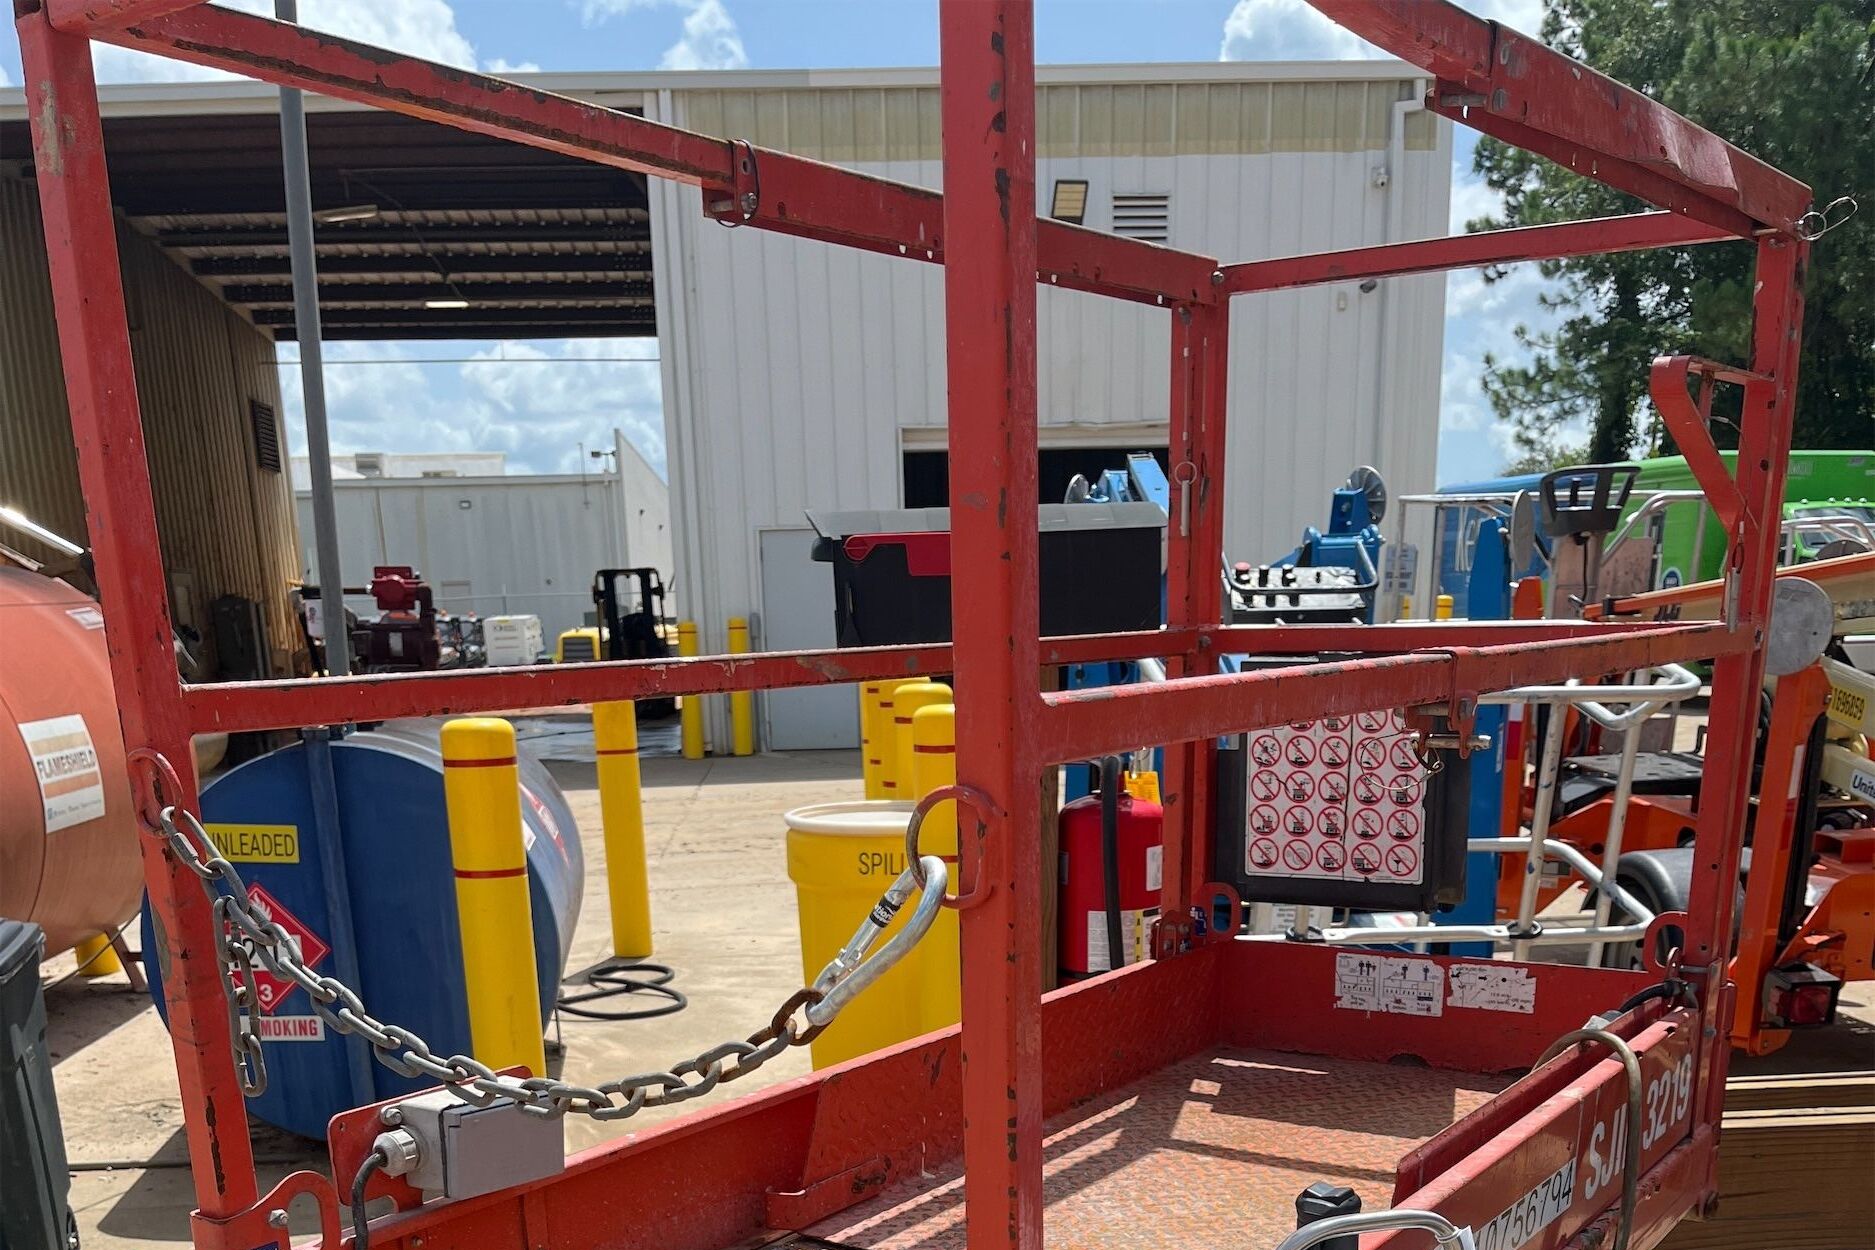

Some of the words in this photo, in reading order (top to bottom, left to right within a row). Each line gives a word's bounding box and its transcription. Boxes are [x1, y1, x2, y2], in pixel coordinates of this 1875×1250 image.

[1853, 774, 1875, 799] Unit
[261, 1019, 319, 1037] MOKING
[1642, 1052, 1693, 1151] 3219
